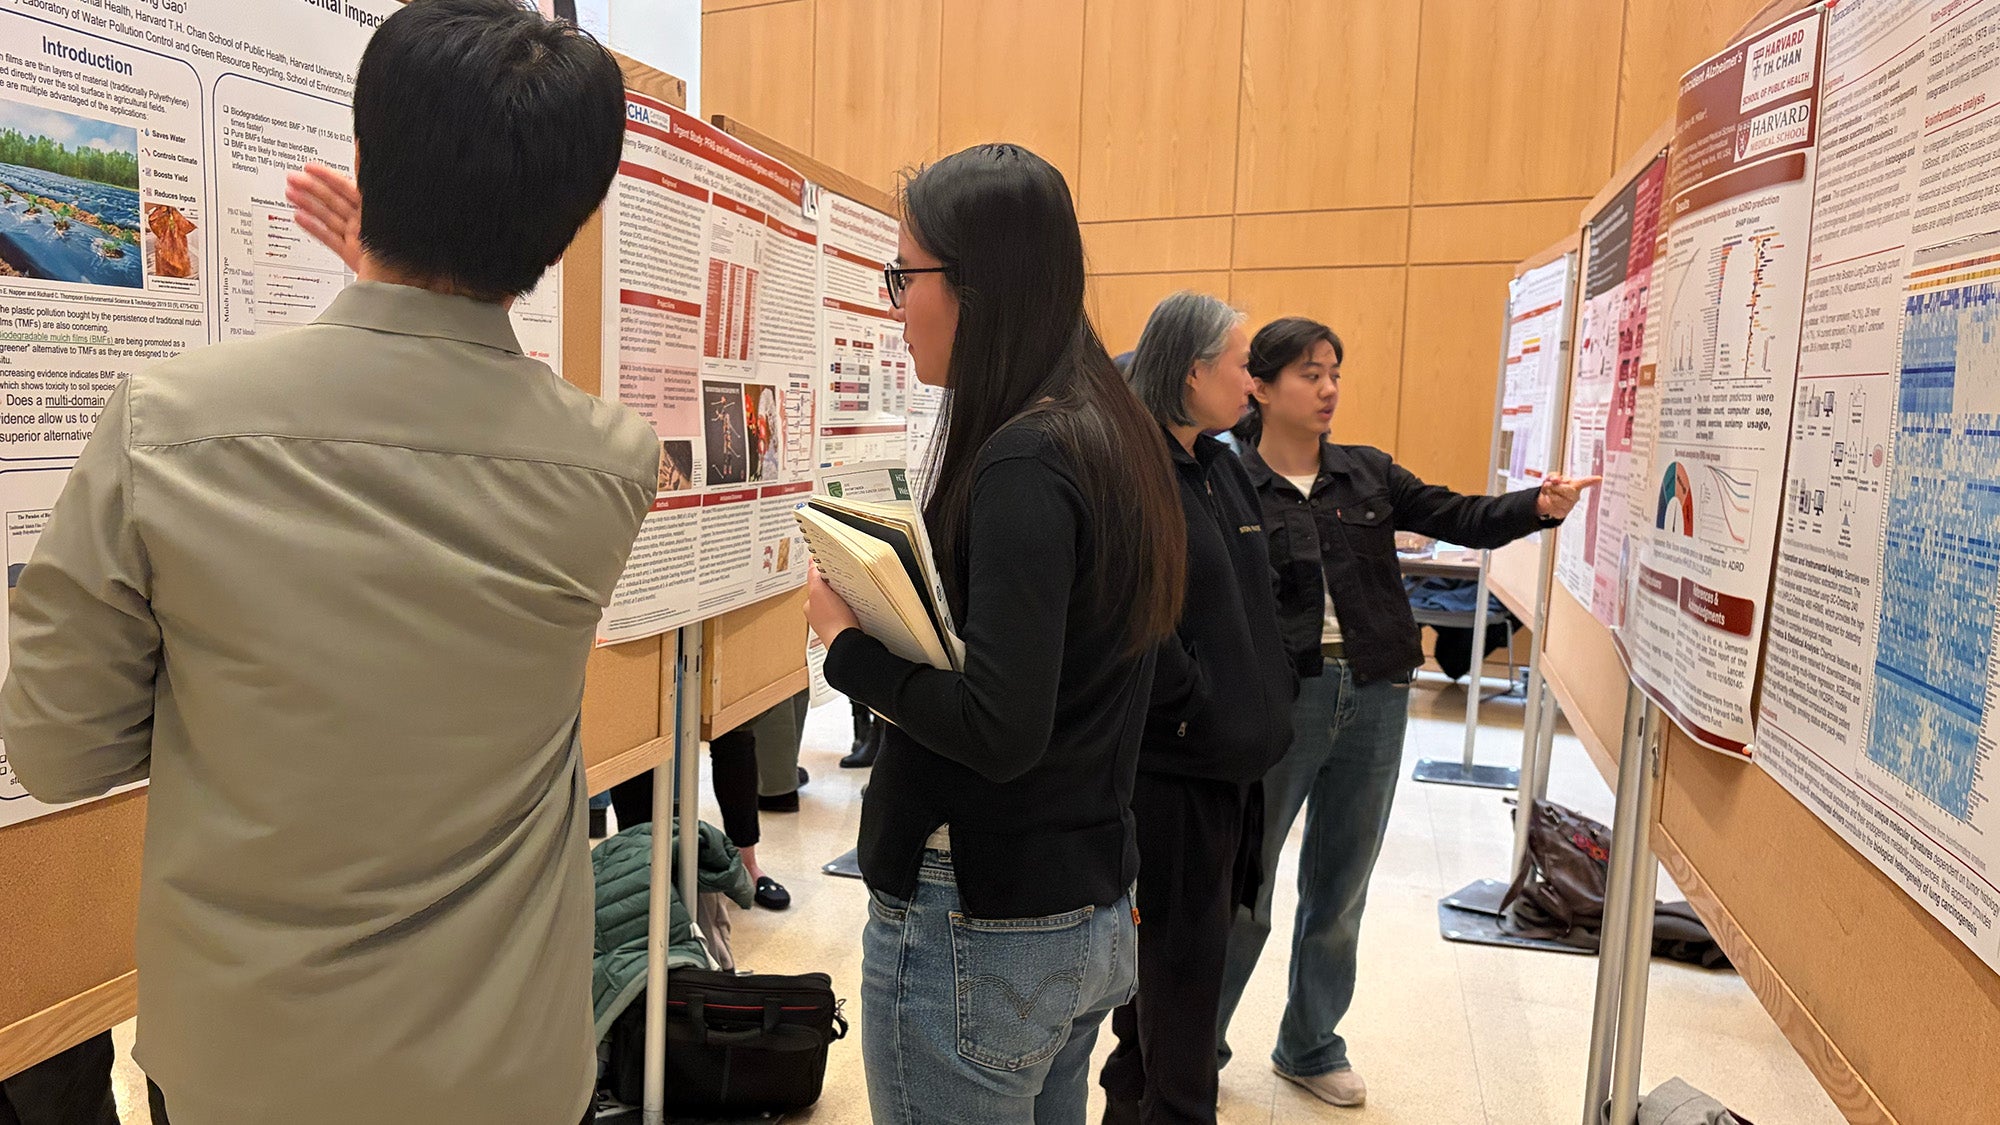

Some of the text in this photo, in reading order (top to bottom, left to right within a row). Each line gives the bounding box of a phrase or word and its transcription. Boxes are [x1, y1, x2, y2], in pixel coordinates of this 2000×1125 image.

[104, 0, 133, 19] Health,
[135, 9, 167, 28] Harvard
[168, 19, 185, 33] T.H.
[187, 25, 207, 40] Chan
[208, 31, 234, 48] School
[235, 40, 243, 50] of
[244, 42, 265, 58] Public
[266, 48, 289, 66] Health,
[290, 56, 315, 73] Harvard
[1764, 28, 1805, 59] HARVARD
[42, 35, 133, 77] Introduction
[71, 9, 81, 20] of
[82, 11, 107, 29] Water
[109, 19, 144, 39] Pollution
[145, 30, 174, 47] Control
[175, 40, 190, 53] and
[191, 44, 215, 60] Green
[216, 51, 251, 70] Resource
[252, 61, 286, 82] Recycling,
[286, 71, 309, 87] School
[309, 78, 316, 88] of
[1705, 49, 1743, 81] Alzheimer's
[1775, 47, 1802, 71] CHAN
[5, 52, 23, 66] films
[24, 59, 37, 70] are
[38, 61, 52, 74] thin
[52, 65, 73, 79] layers
[74, 71, 82, 81] of
[82, 74, 109, 88] material
[6, 80, 110, 112] are multiple advantaged of the
[10, 68, 37, 84] directly
[38, 76, 55, 87] over
[55, 79, 68, 90] the
[67, 83, 80, 93] soil
[80, 86, 106, 100] surface
[106, 91, 114, 100] in
[113, 94, 148, 110] agricultural
[1742, 71, 1810, 107] SCHOOL OF PUBLIC HEALTH
[230, 106, 271, 124] Biodegradation
[627, 103, 650, 124] CHA
[1751, 104, 1809, 138] HARVARD
[152, 129, 187, 144] Saves Water
[1776, 127, 1806, 143] SCHOOL
[152, 149, 199, 166] Controls Climate
[153, 169, 189, 183] Boosts Yield
[154, 189, 197, 203] Reduces Inputs
[11, 305, 35, 316] plastic
[36, 307, 66, 318] pollution
[66, 309, 90, 321] bought
[91, 312, 100, 322] by
[100, 312, 112, 321] the
[112, 314, 148, 324] persistence
[148, 315, 156, 324] of
[155, 316, 184, 326] traditional
[14, 317, 110, 334] (TMFs) are also concerning.
[50, 333, 71, 342] mulch
[71, 334, 89, 344] films
[114, 337, 125, 345] are
[125, 336, 143, 348] being
[144, 338, 172, 348] promoted
[172, 340, 181, 348] as
[31, 344, 69, 354] alternative
[69, 346, 77, 355] to
[77, 346, 97, 356] TMFs
[98, 348, 107, 356] as
[107, 347, 122, 358] they
[133, 350, 162, 359] designed
[36, 369, 116, 379] evidence indicates BMF
[21, 381, 45, 390] shows
[45, 382, 70, 393] toxicity
[70, 383, 78, 391] to
[78, 382, 91, 391] soil
[6, 393, 106, 407] Does a multi-domain
[38, 413, 89, 424] allow us to
[0, 428, 93, 445] superior alternative
